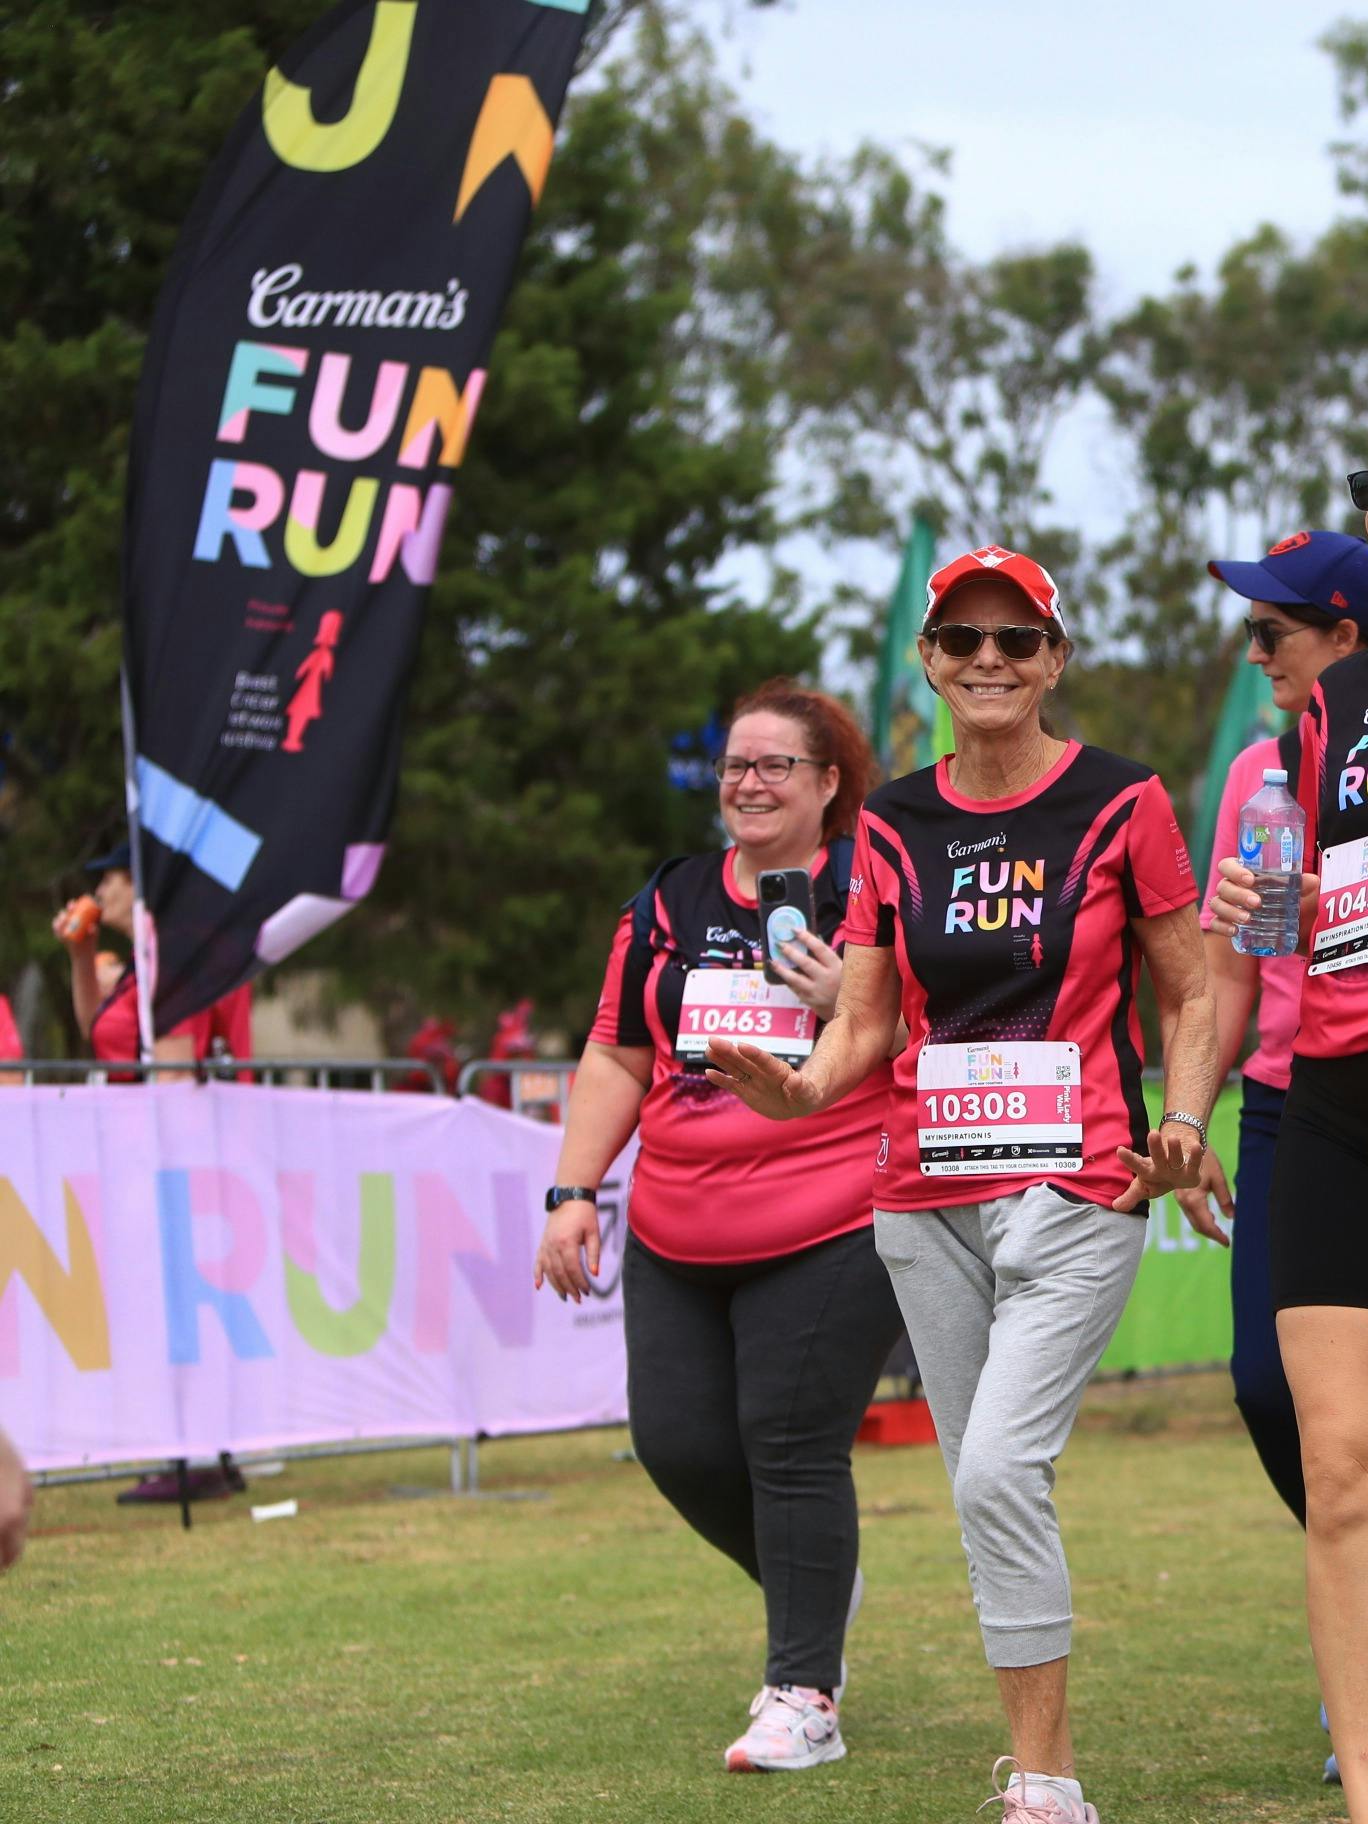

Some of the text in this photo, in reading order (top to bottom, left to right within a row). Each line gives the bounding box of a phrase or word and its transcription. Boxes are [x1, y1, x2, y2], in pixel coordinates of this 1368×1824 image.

[248, 263, 468, 329] Carman's
[216, 340, 487, 470] FUN
[192, 458, 453, 585] RUN
[946, 831, 1007, 859] Carman's
[950, 859, 1045, 899] FUN
[944, 897, 1043, 934] RUN
[1328, 925, 1364, 941] INSPIRATION
[688, 1009, 772, 1033] 10463
[968, 1053, 1003, 1066] FUN
[968, 1067, 1003, 1081] RUN
[925, 1091, 1027, 1123] 10308
[1056, 1094, 1064, 1114] Walk
[1062, 1086, 1071, 1123] Pink Lady
[936, 1133, 983, 1141] INSPIRATION
[156, 1168, 535, 1365] RUN
